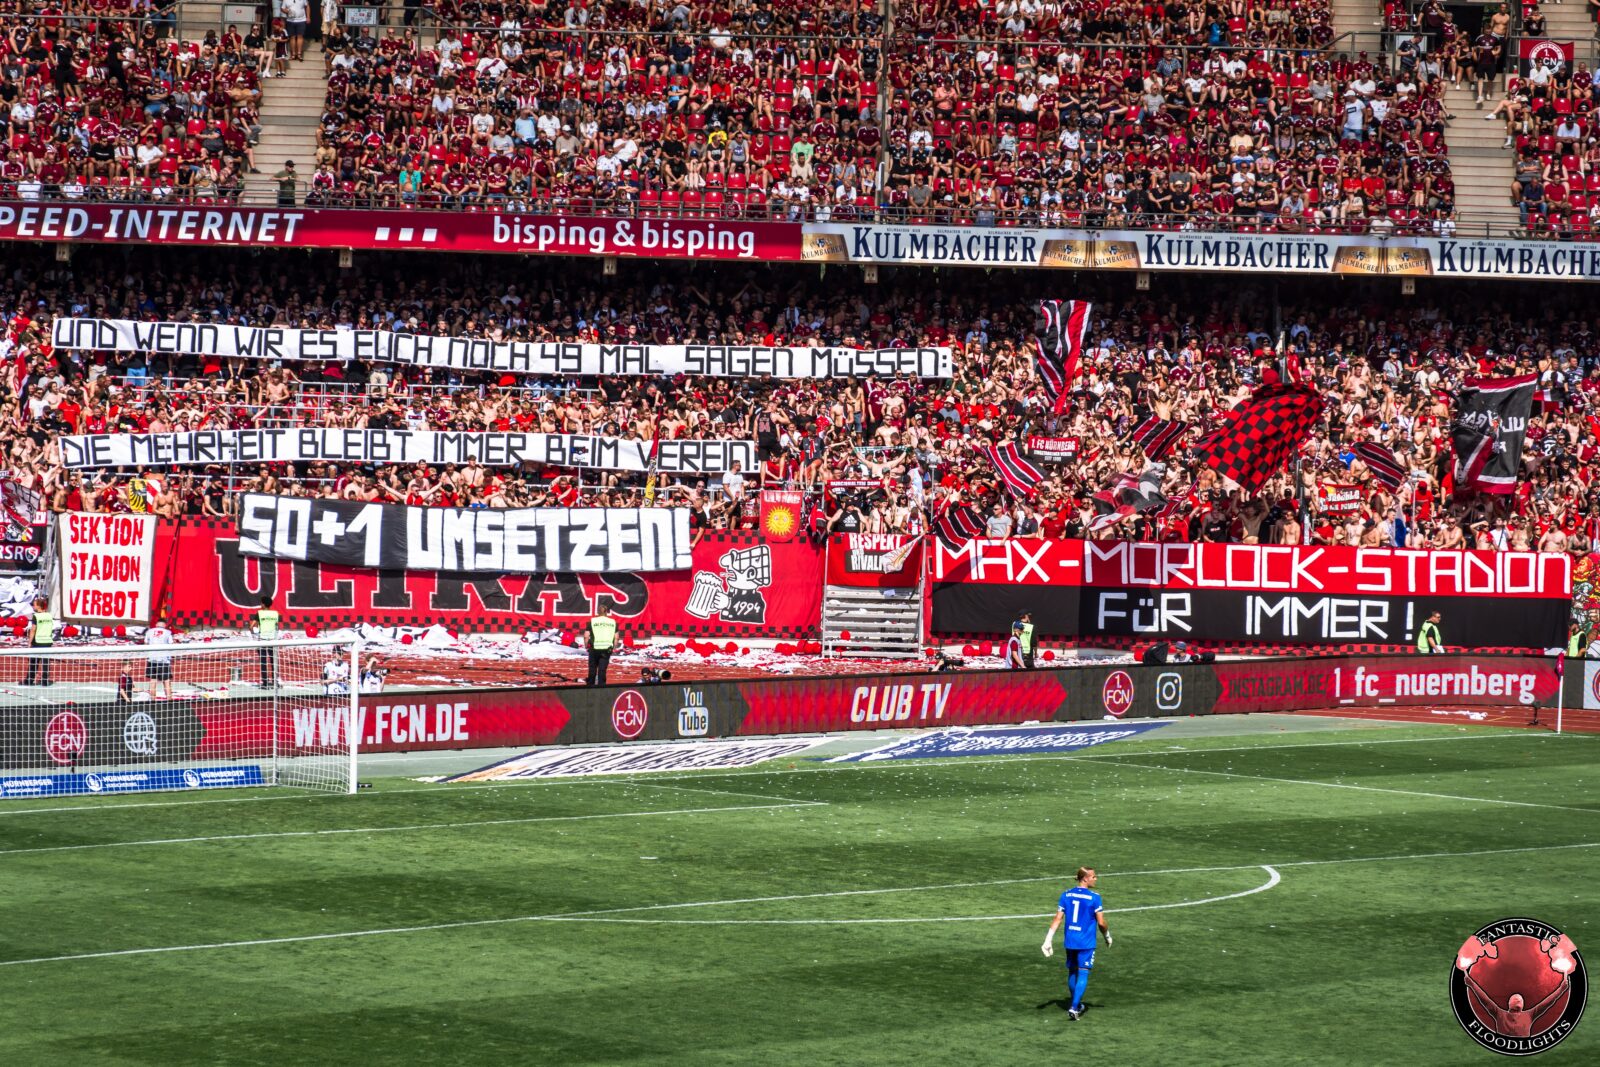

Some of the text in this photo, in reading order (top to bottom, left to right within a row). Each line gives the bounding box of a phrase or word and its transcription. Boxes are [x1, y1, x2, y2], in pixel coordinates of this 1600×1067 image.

[493, 216, 755, 258] bisping & bisping
[853, 227, 1037, 262] KULMBACHER
[1144, 233, 1329, 268] KULMBACHER
[56, 319, 117, 349] UND
[133, 323, 218, 354] WENN
[235, 327, 284, 358] WIR
[300, 330, 339, 361] ES
[354, 331, 435, 364] EUCH
[448, 338, 530, 371] NOCH
[540, 344, 583, 374] 49
[600, 345, 664, 374] MAL
[685, 346, 794, 376] SAGEN
[60, 428, 760, 472] DIE MEHRHEIT BLEIBT IMMER BEIM VEREIN!
[69, 514, 144, 546] SEKTION
[239, 494, 693, 571] 50+1 UMSETZEN!
[849, 533, 903, 550] RESPEKT
[70, 551, 140, 582] STADION
[69, 589, 139, 619] VERBOT
[732, 601, 761, 616] 1994
[683, 687, 703, 707] You
[851, 683, 952, 723] CLUB TV
[1106, 688, 1131, 705] FCN
[293, 702, 469, 747] WWW.FCN.DE
[616, 709, 643, 726] FCN
[679, 709, 707, 732] Tube
[49, 732, 82, 751] FCN
[1072, 900, 1080, 923] 1
